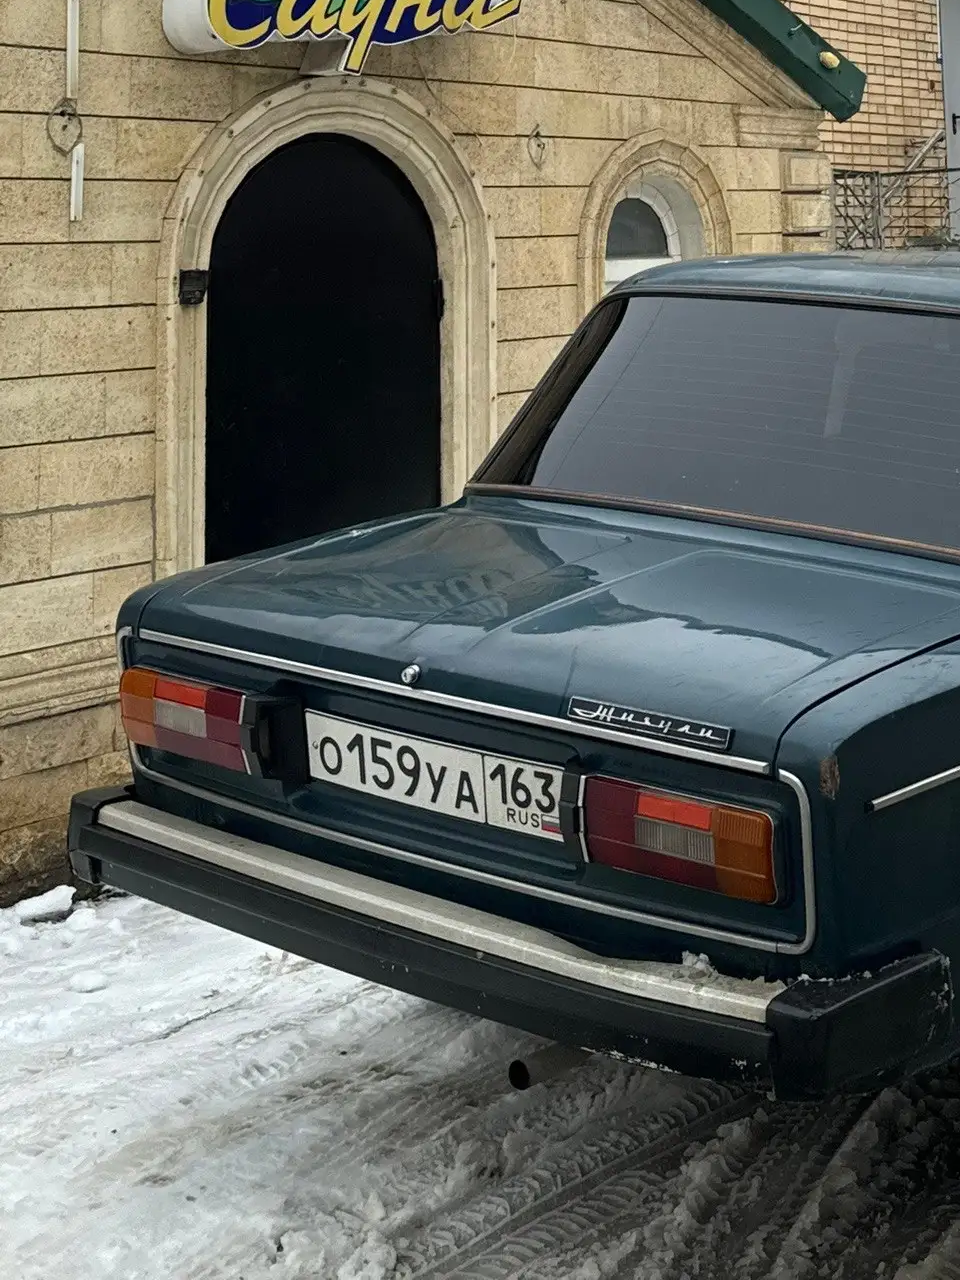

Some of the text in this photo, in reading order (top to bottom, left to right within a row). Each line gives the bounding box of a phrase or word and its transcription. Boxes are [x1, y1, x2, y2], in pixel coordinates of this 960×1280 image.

[572, 704, 726, 741] Жигули
[489, 763, 556, 813] 163
[506, 807, 540, 829] RUS
